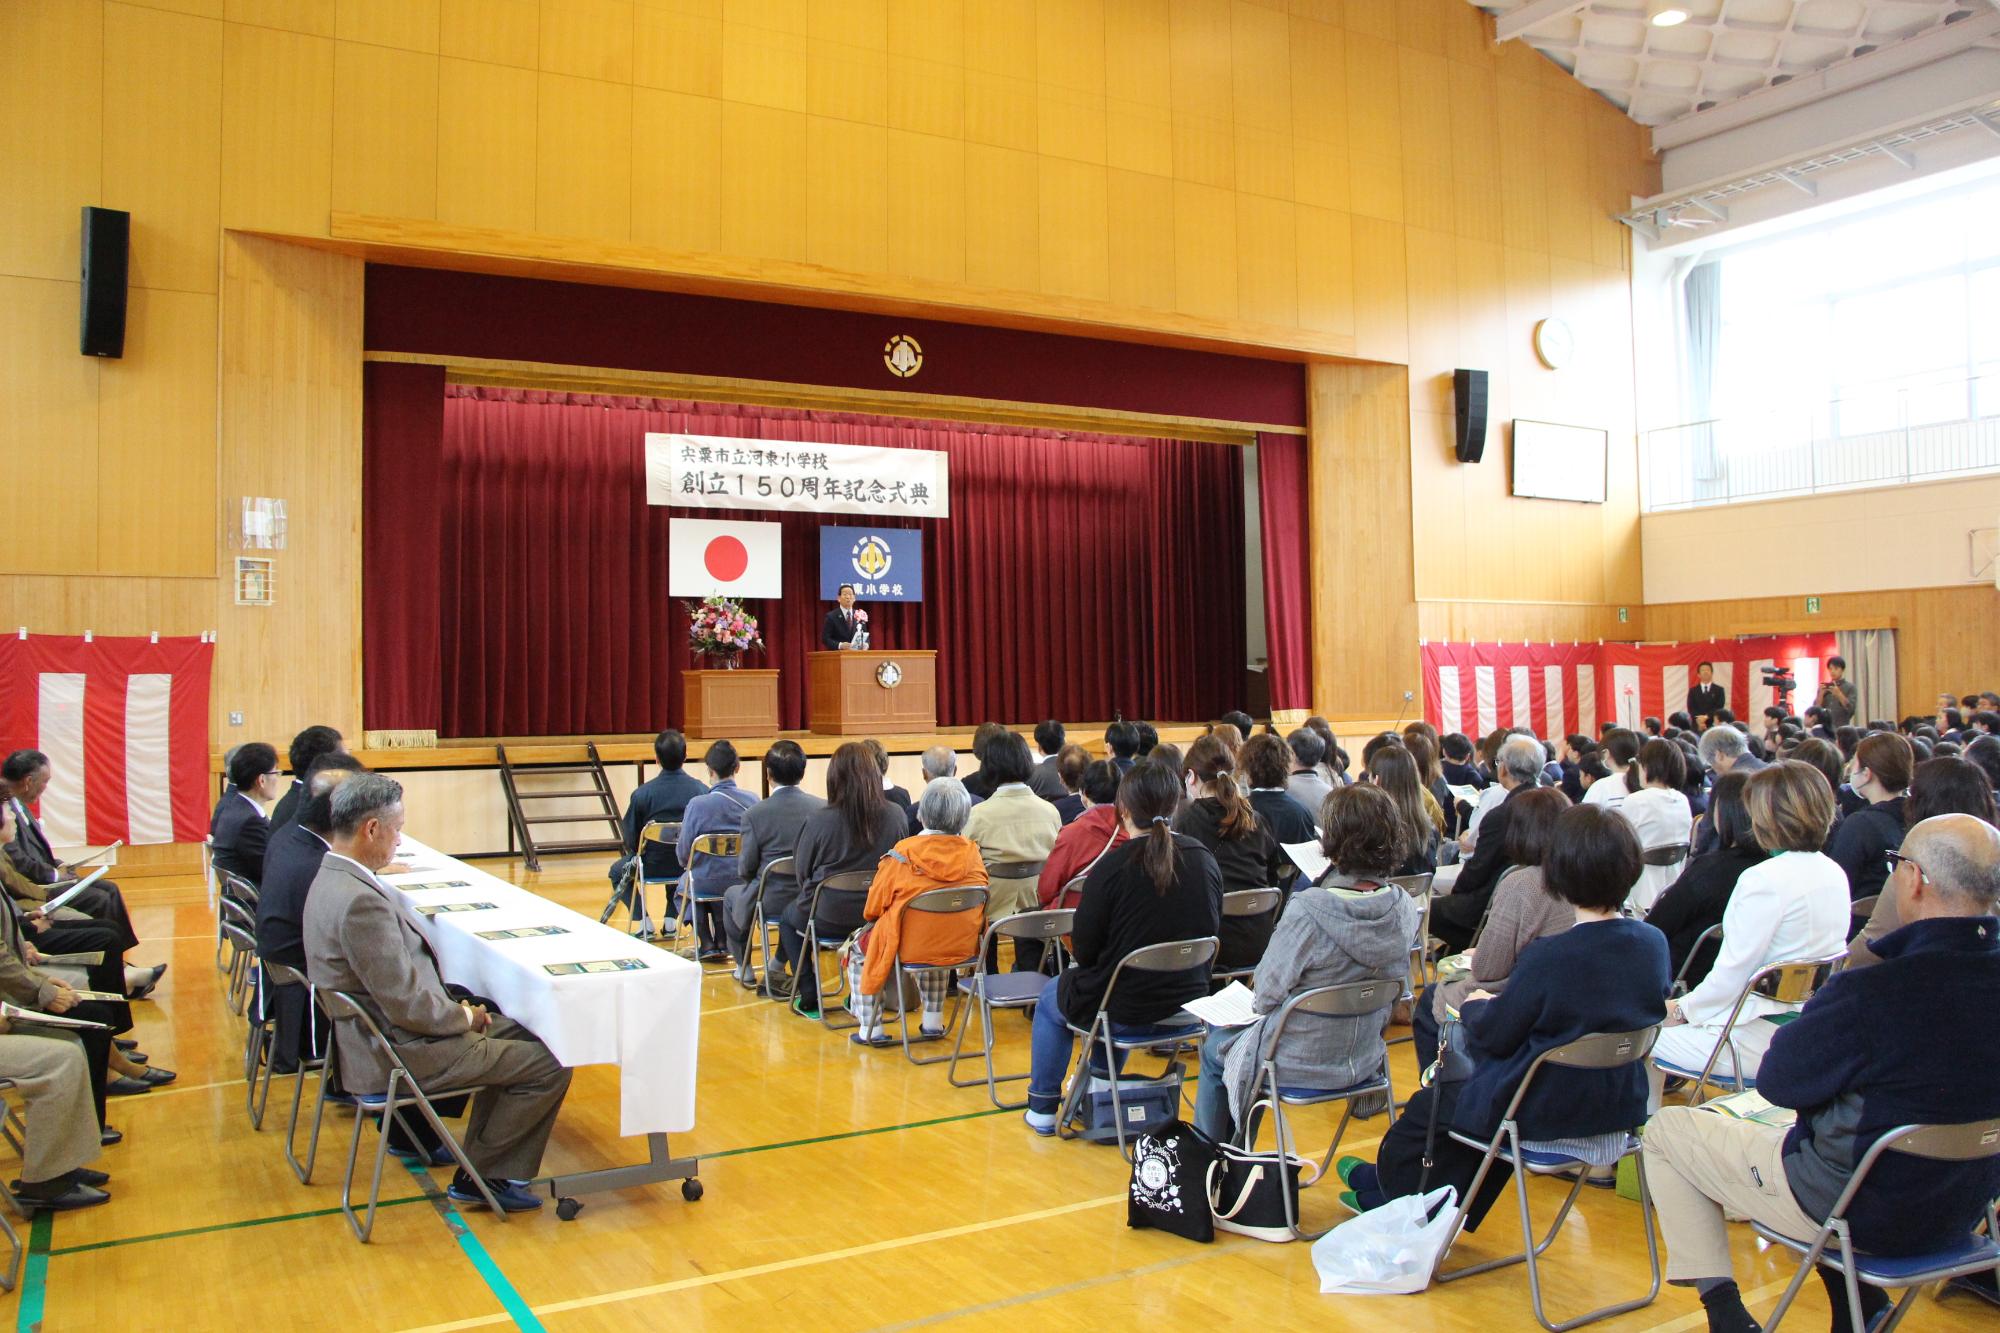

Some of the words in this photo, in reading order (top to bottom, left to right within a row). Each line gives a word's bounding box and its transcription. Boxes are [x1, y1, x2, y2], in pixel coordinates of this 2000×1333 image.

[681, 446, 829, 471] 宍粟市立河東小学校
[841, 582, 904, 596] 東小学校
